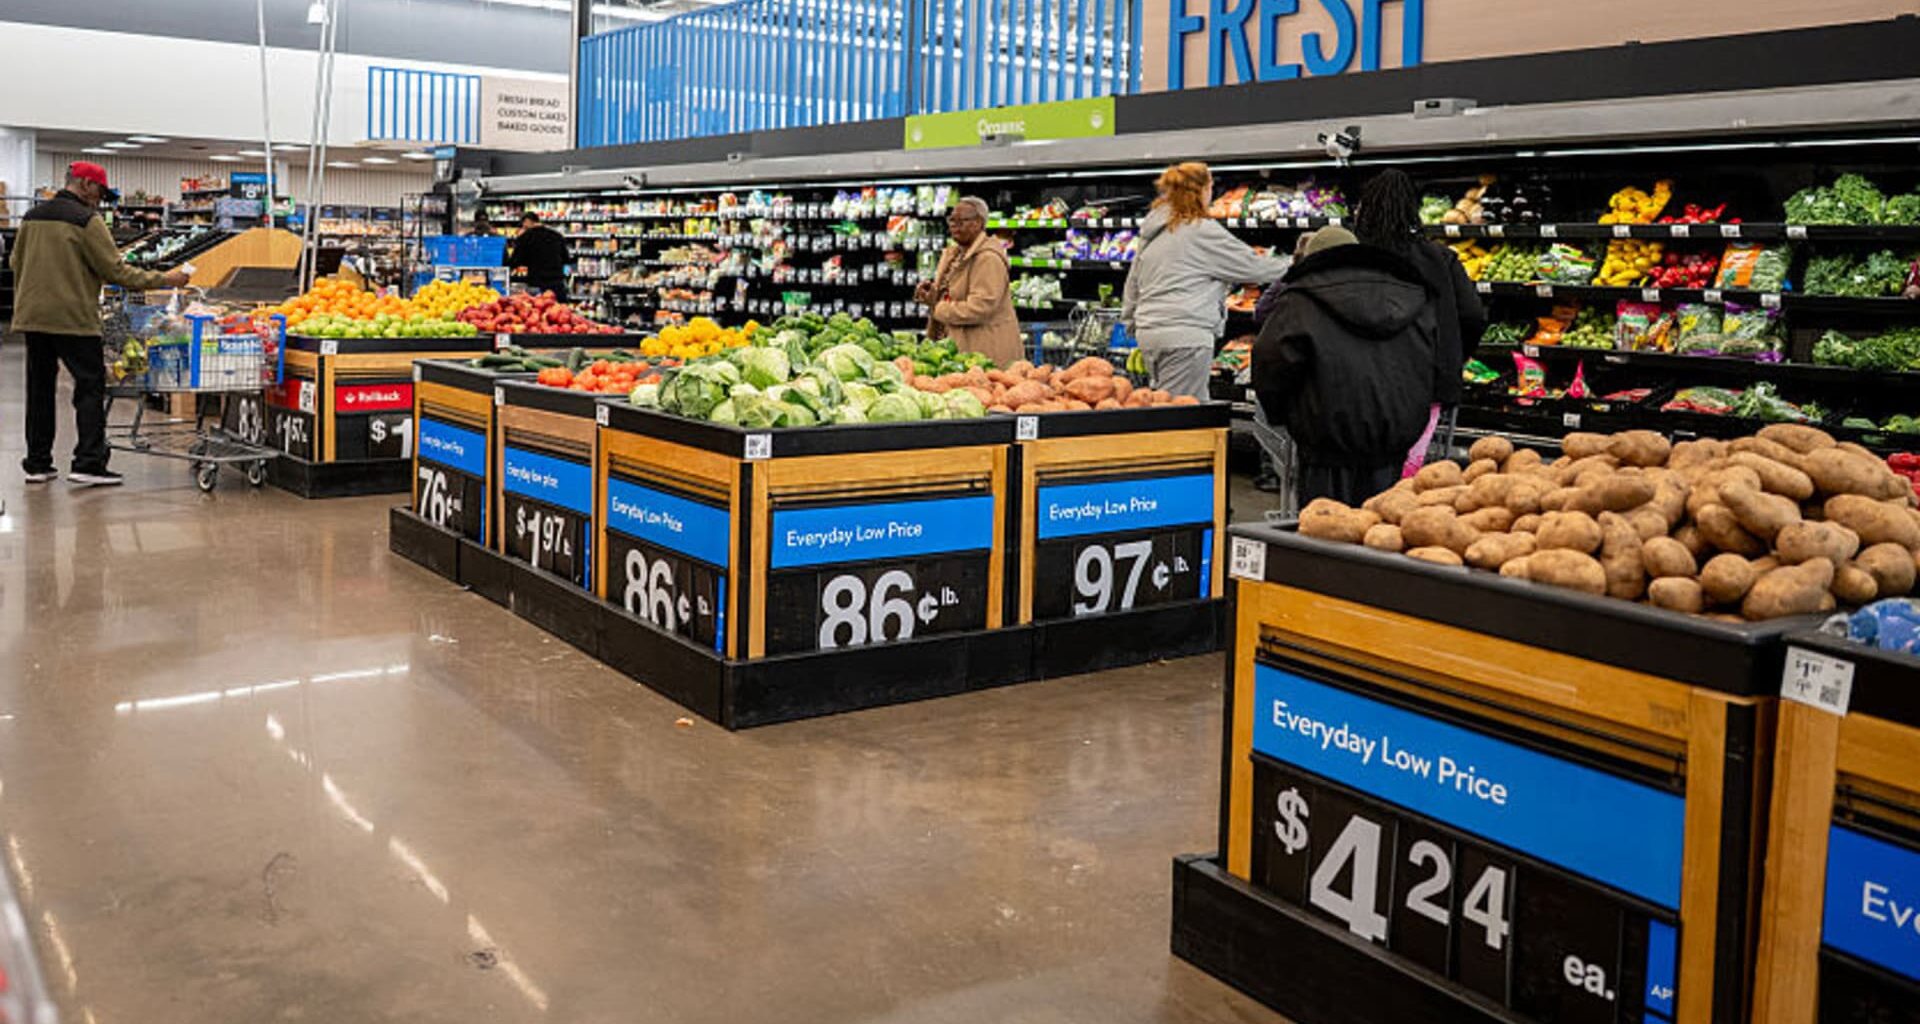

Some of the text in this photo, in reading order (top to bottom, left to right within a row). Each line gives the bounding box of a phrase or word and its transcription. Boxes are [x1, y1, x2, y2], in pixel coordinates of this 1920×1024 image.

[1168, 0, 1424, 90] FRESH
[498, 94, 560, 108] FRESH BREAD
[497, 107, 567, 122] CUSTOM CAKES
[497, 121, 564, 134] BAKED GOODS
[977, 118, 1025, 136] Organic
[358, 390, 401, 402] Rollback
[507, 461, 531, 485] Everyday
[612, 496, 643, 523] Everyday
[662, 511, 683, 532] Price
[1049, 496, 1158, 521] Everyday Low Price
[786, 520, 923, 549] Everyday Low Price
[941, 586, 960, 606] lb.
[1272, 699, 1508, 805] Everyday Low Price
[1563, 955, 1616, 1001] ea.
